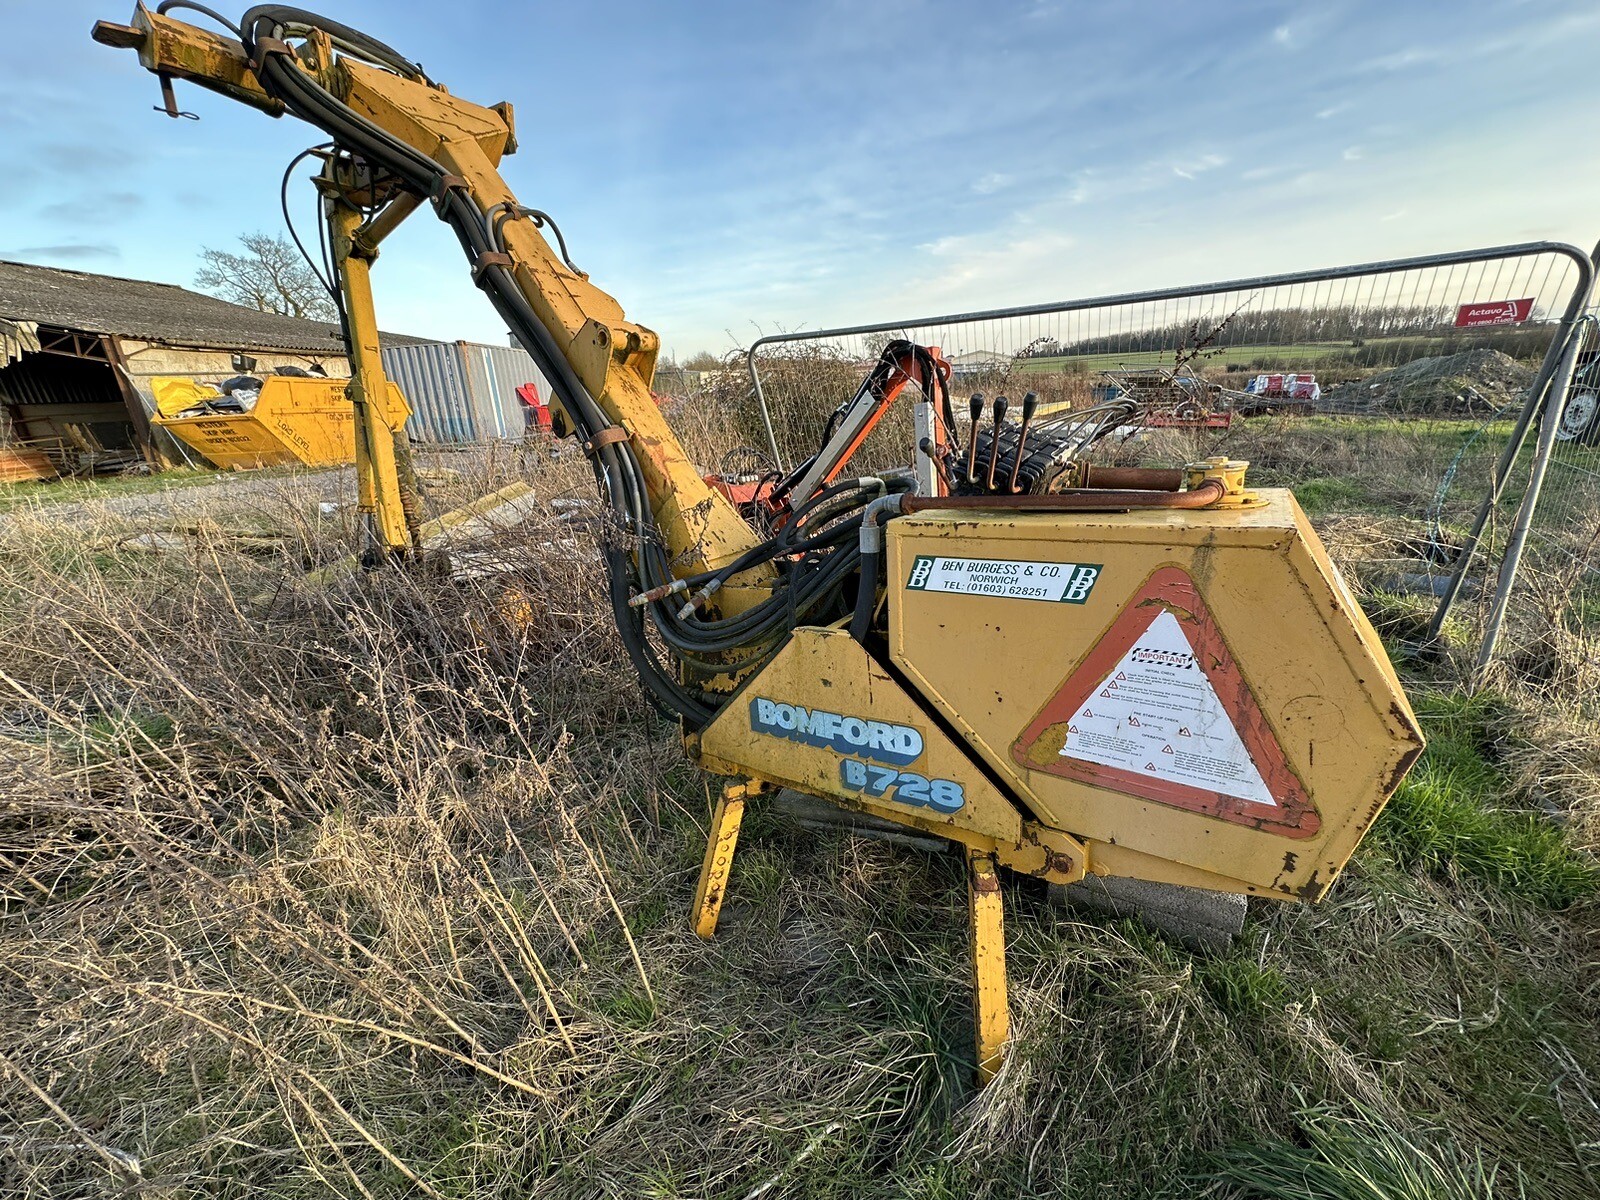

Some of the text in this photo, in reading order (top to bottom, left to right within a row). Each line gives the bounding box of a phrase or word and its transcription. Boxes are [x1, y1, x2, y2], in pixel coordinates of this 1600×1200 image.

[277, 416, 310, 451] LOAD LEVEL
[941, 560, 1061, 578] BEN BURGESS & CO.
[969, 573, 1019, 586] NORWICH
[943, 580, 1048, 597] TEL: (01603) 628251
[1137, 651, 1188, 665] IMPORTANT
[1142, 712, 1156, 720] START
[750, 697, 924, 764] BOMFORD
[1141, 733, 1167, 742] OPERATION
[840, 758, 965, 814] B728
